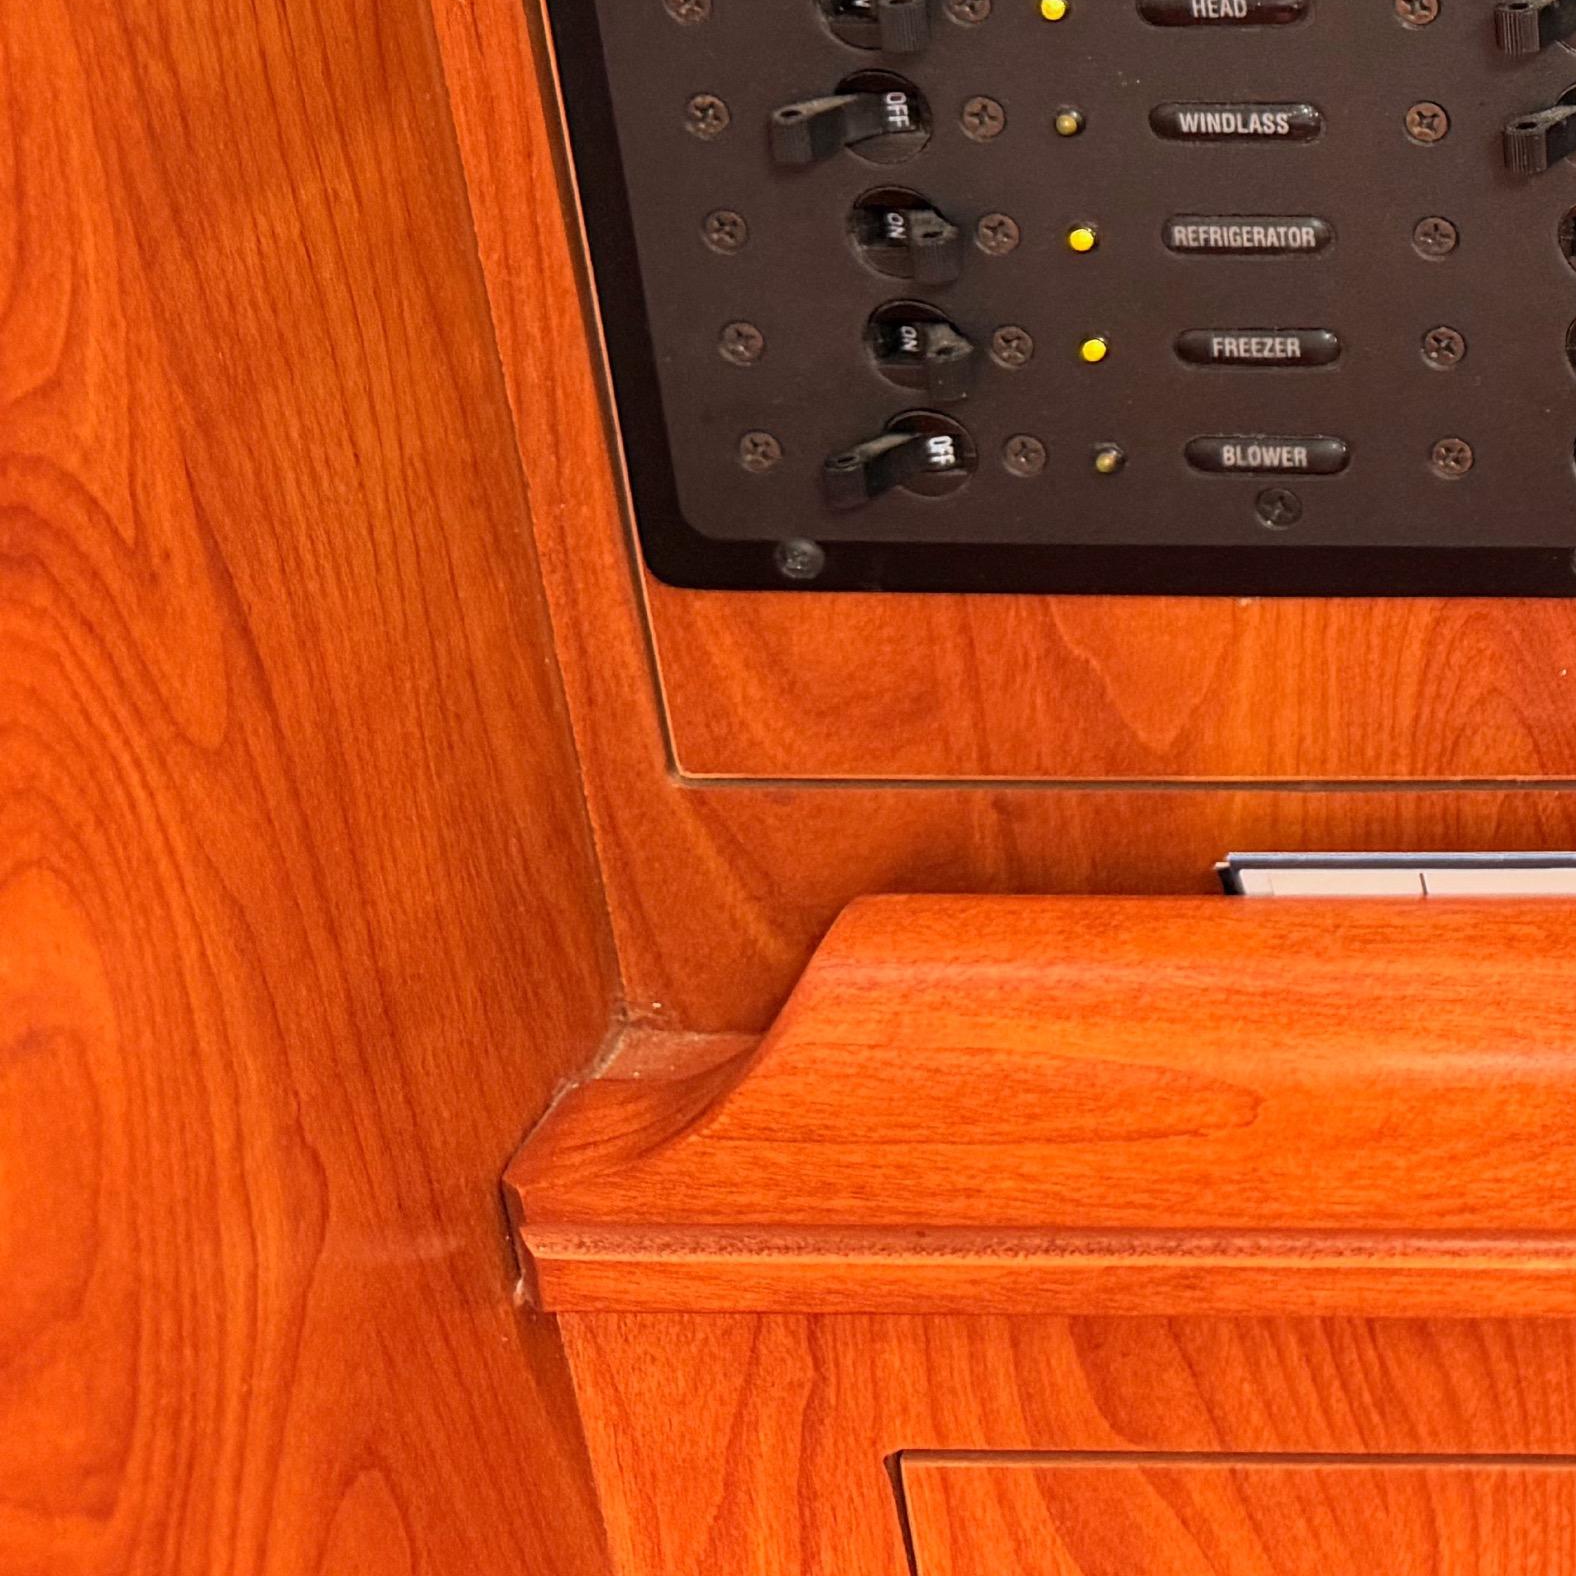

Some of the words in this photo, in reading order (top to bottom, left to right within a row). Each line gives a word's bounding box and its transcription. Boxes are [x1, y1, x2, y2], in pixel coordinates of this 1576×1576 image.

[886, 91, 910, 129] OFF
[1179, 113, 1290, 135] WINDLASS
[886, 212, 905, 240] ON
[1173, 226, 1315, 248] REFRIGERATOR
[901, 325, 917, 352] ON
[1211, 337, 1300, 358] FREEZER
[926, 434, 956, 467] OFF
[1222, 446, 1307, 467] BLOWER
